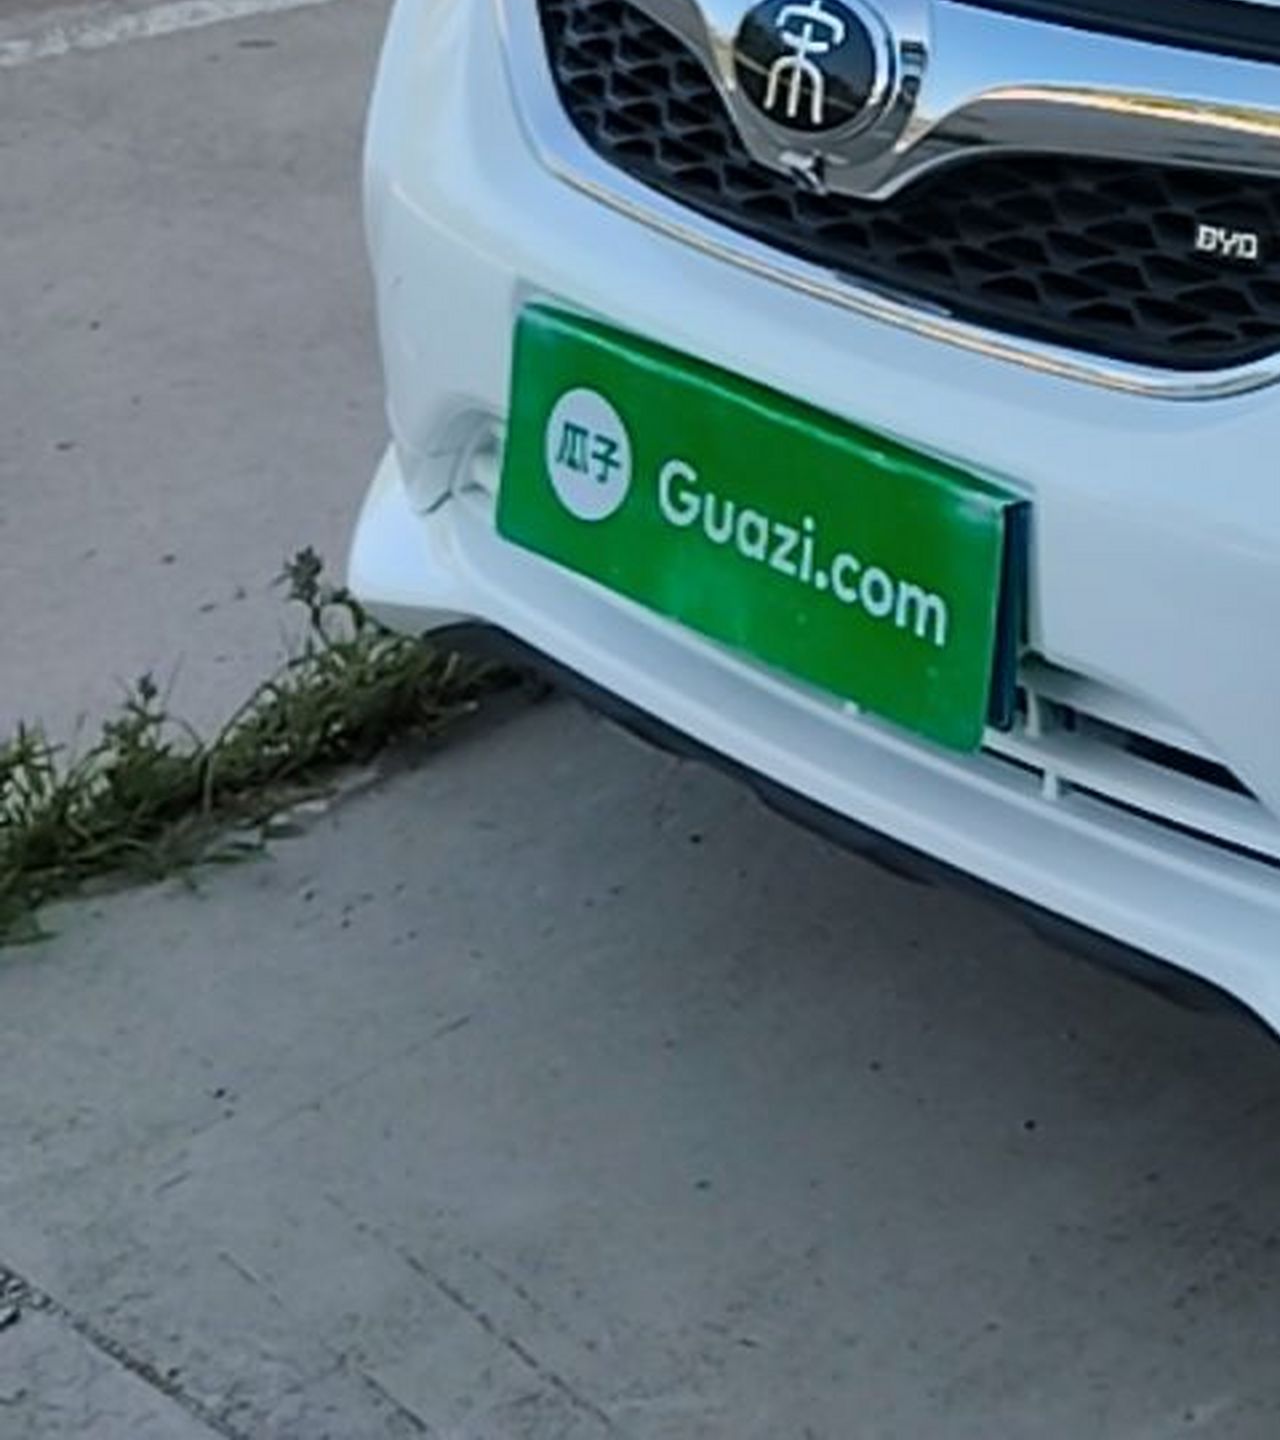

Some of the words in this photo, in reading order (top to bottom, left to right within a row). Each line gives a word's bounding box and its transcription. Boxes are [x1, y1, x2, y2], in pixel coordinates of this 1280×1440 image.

[1195, 224, 1257, 258] BYD
[555, 421, 621, 484] 瓜子
[658, 458, 946, 647] Guazi.com
